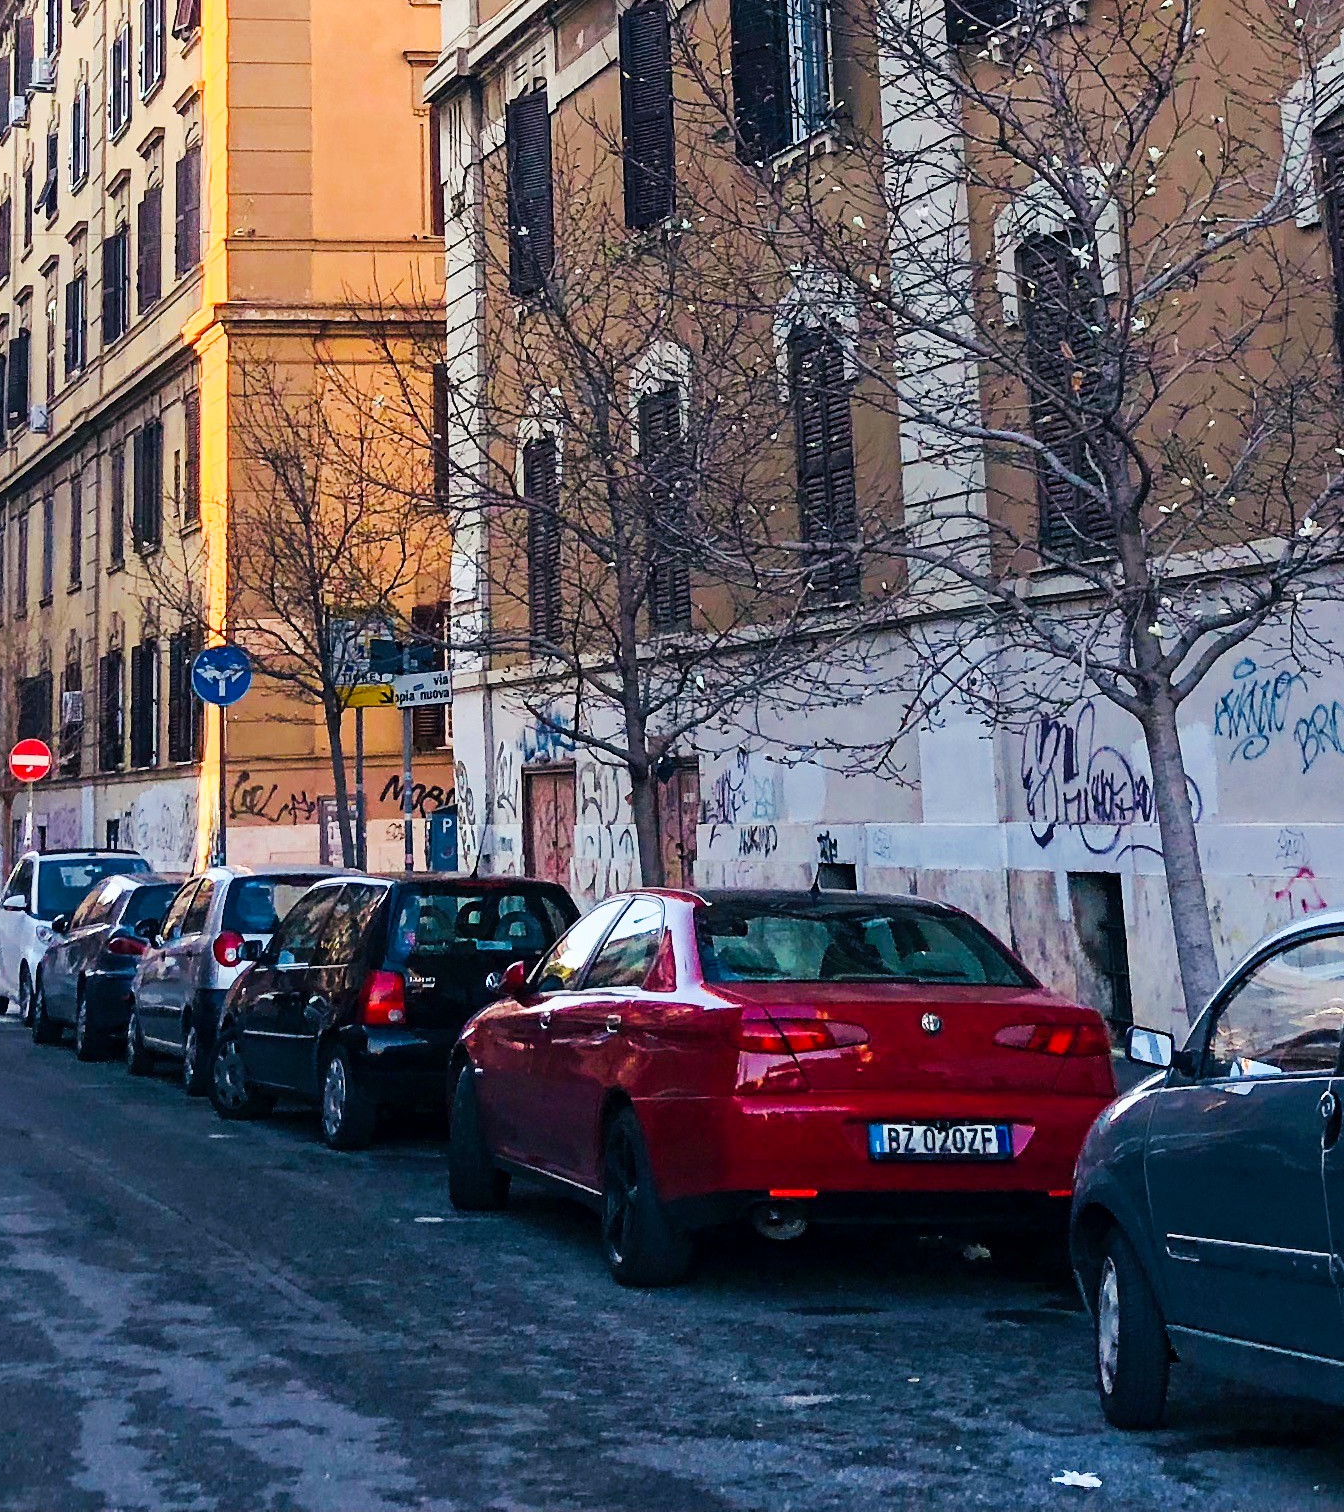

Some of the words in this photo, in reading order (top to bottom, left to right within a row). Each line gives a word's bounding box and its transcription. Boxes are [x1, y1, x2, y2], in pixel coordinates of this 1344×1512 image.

[433, 672, 449, 686] via
[420, 687, 450, 701] nuova
[442, 818, 453, 833] P
